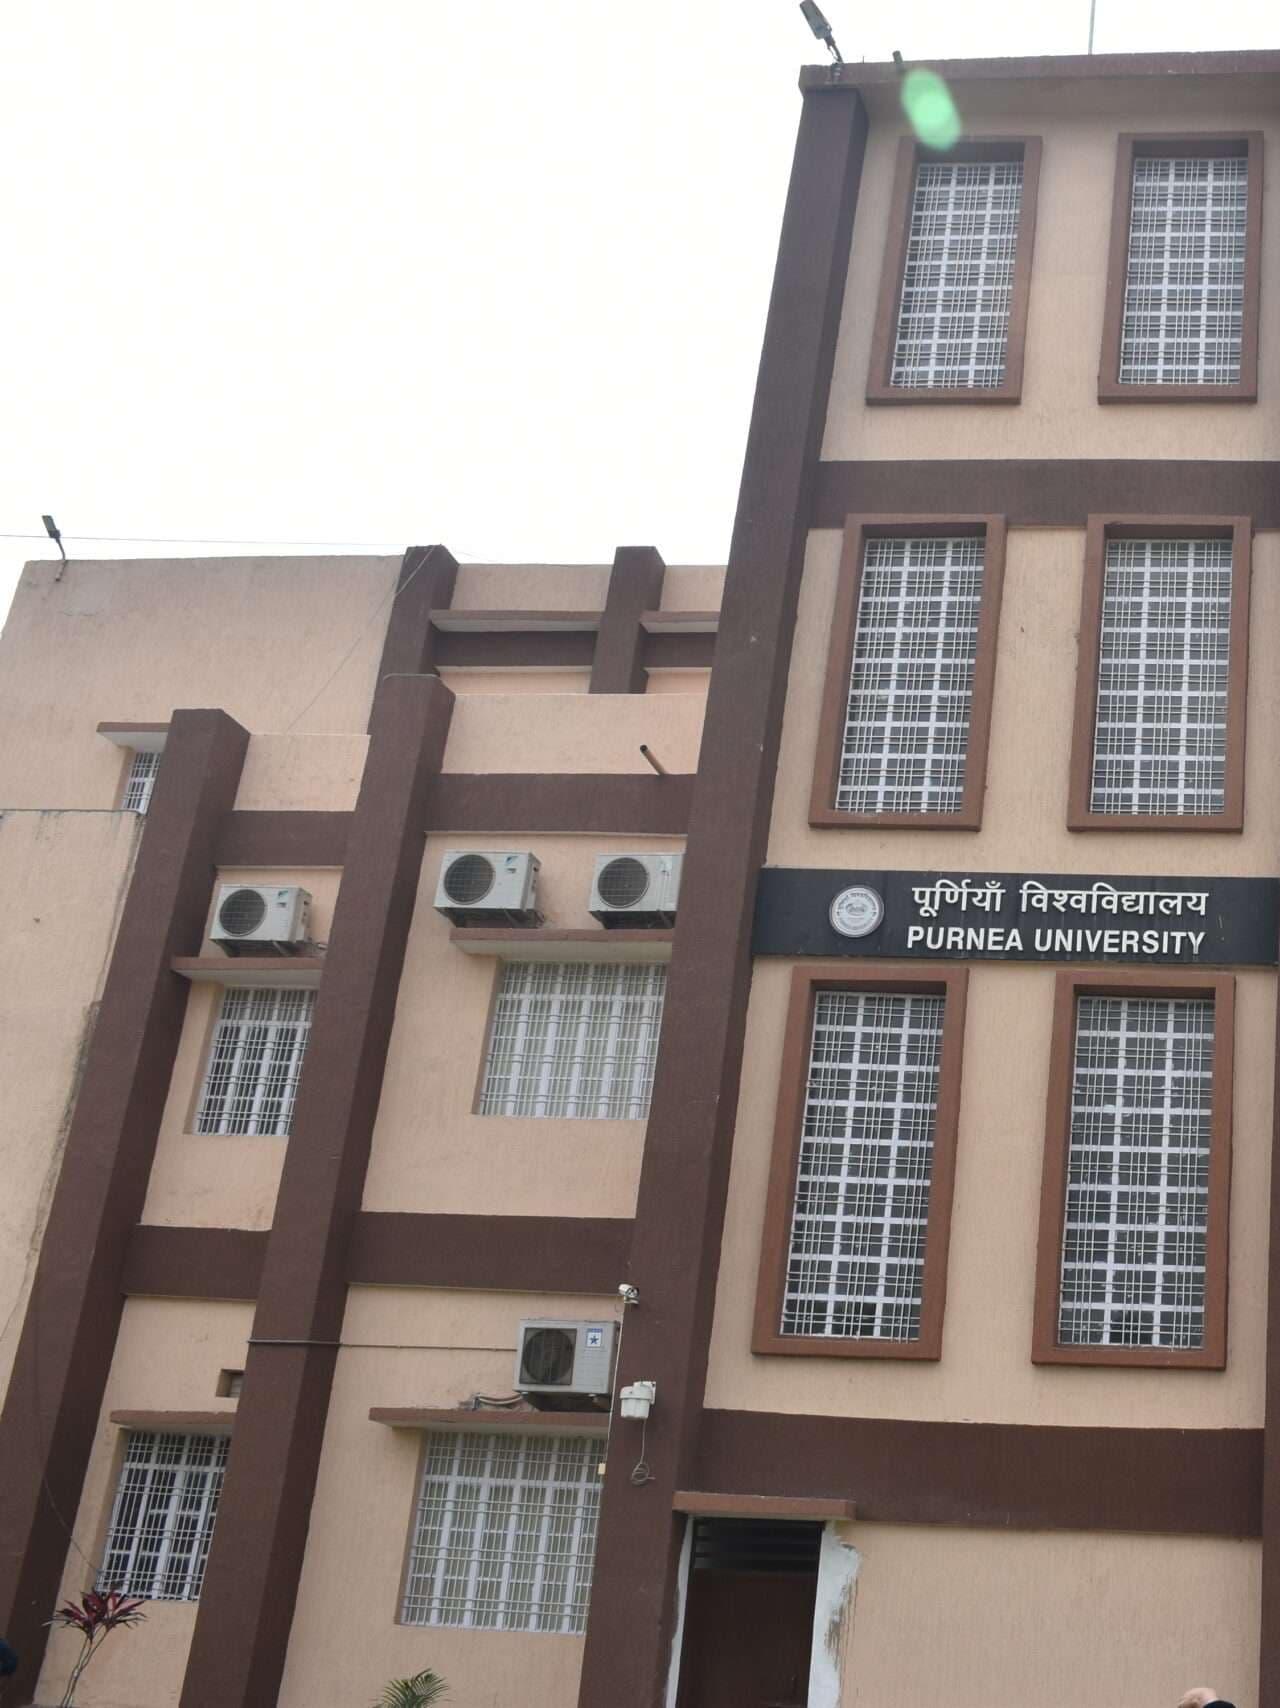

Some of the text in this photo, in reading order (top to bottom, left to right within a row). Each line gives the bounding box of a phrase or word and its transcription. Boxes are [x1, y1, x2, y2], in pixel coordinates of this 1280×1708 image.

[911, 879, 1006, 917] पूर्णियाँ
[1019, 880, 1209, 916] विश्वविद्यालय
[907, 926, 1206, 955] PURNEA UNIVERSITY
